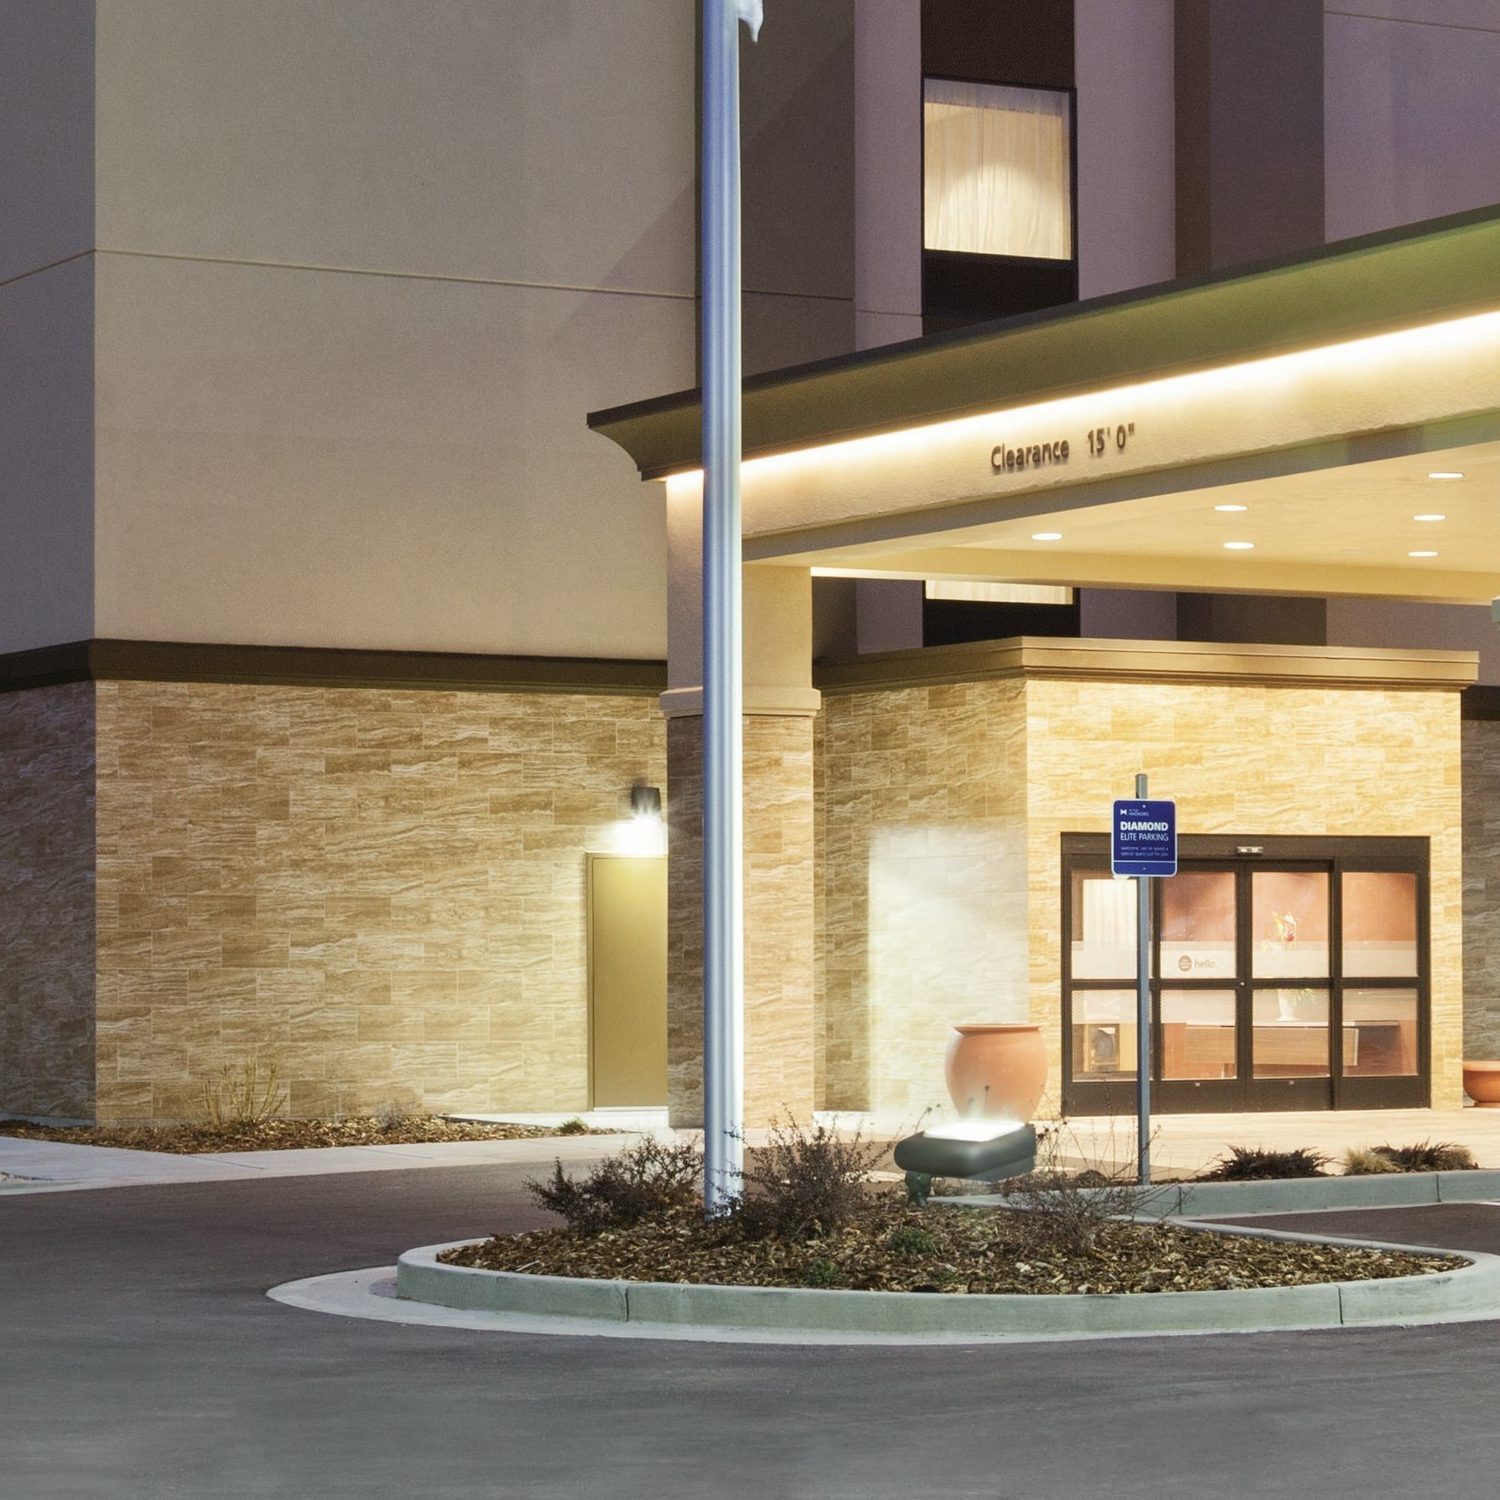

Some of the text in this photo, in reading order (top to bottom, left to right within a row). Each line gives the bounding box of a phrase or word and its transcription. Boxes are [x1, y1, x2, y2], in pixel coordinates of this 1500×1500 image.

[991, 439, 1069, 469] Clearance
[1120, 821, 1169, 831] DIAMOND
[1120, 832, 1169, 841] ELITE PARKING
